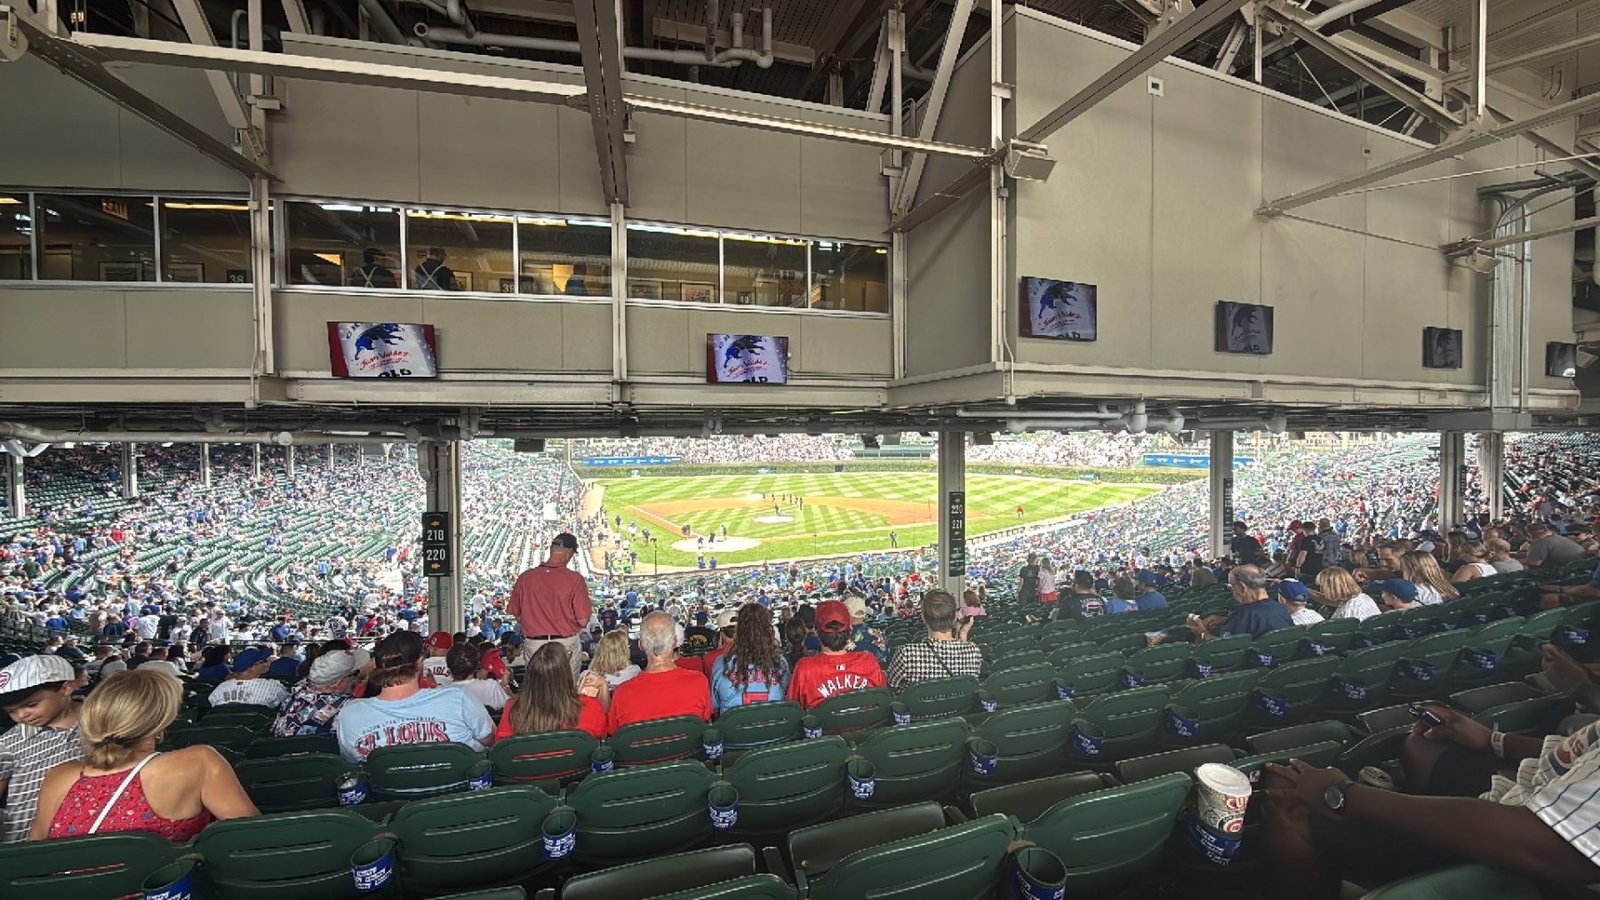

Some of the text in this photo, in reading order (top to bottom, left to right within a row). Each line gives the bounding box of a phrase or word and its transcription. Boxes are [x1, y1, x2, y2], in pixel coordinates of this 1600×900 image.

[426, 529, 445, 541] 218
[426, 548, 446, 561] 220
[817, 674, 869, 698] WALKER
